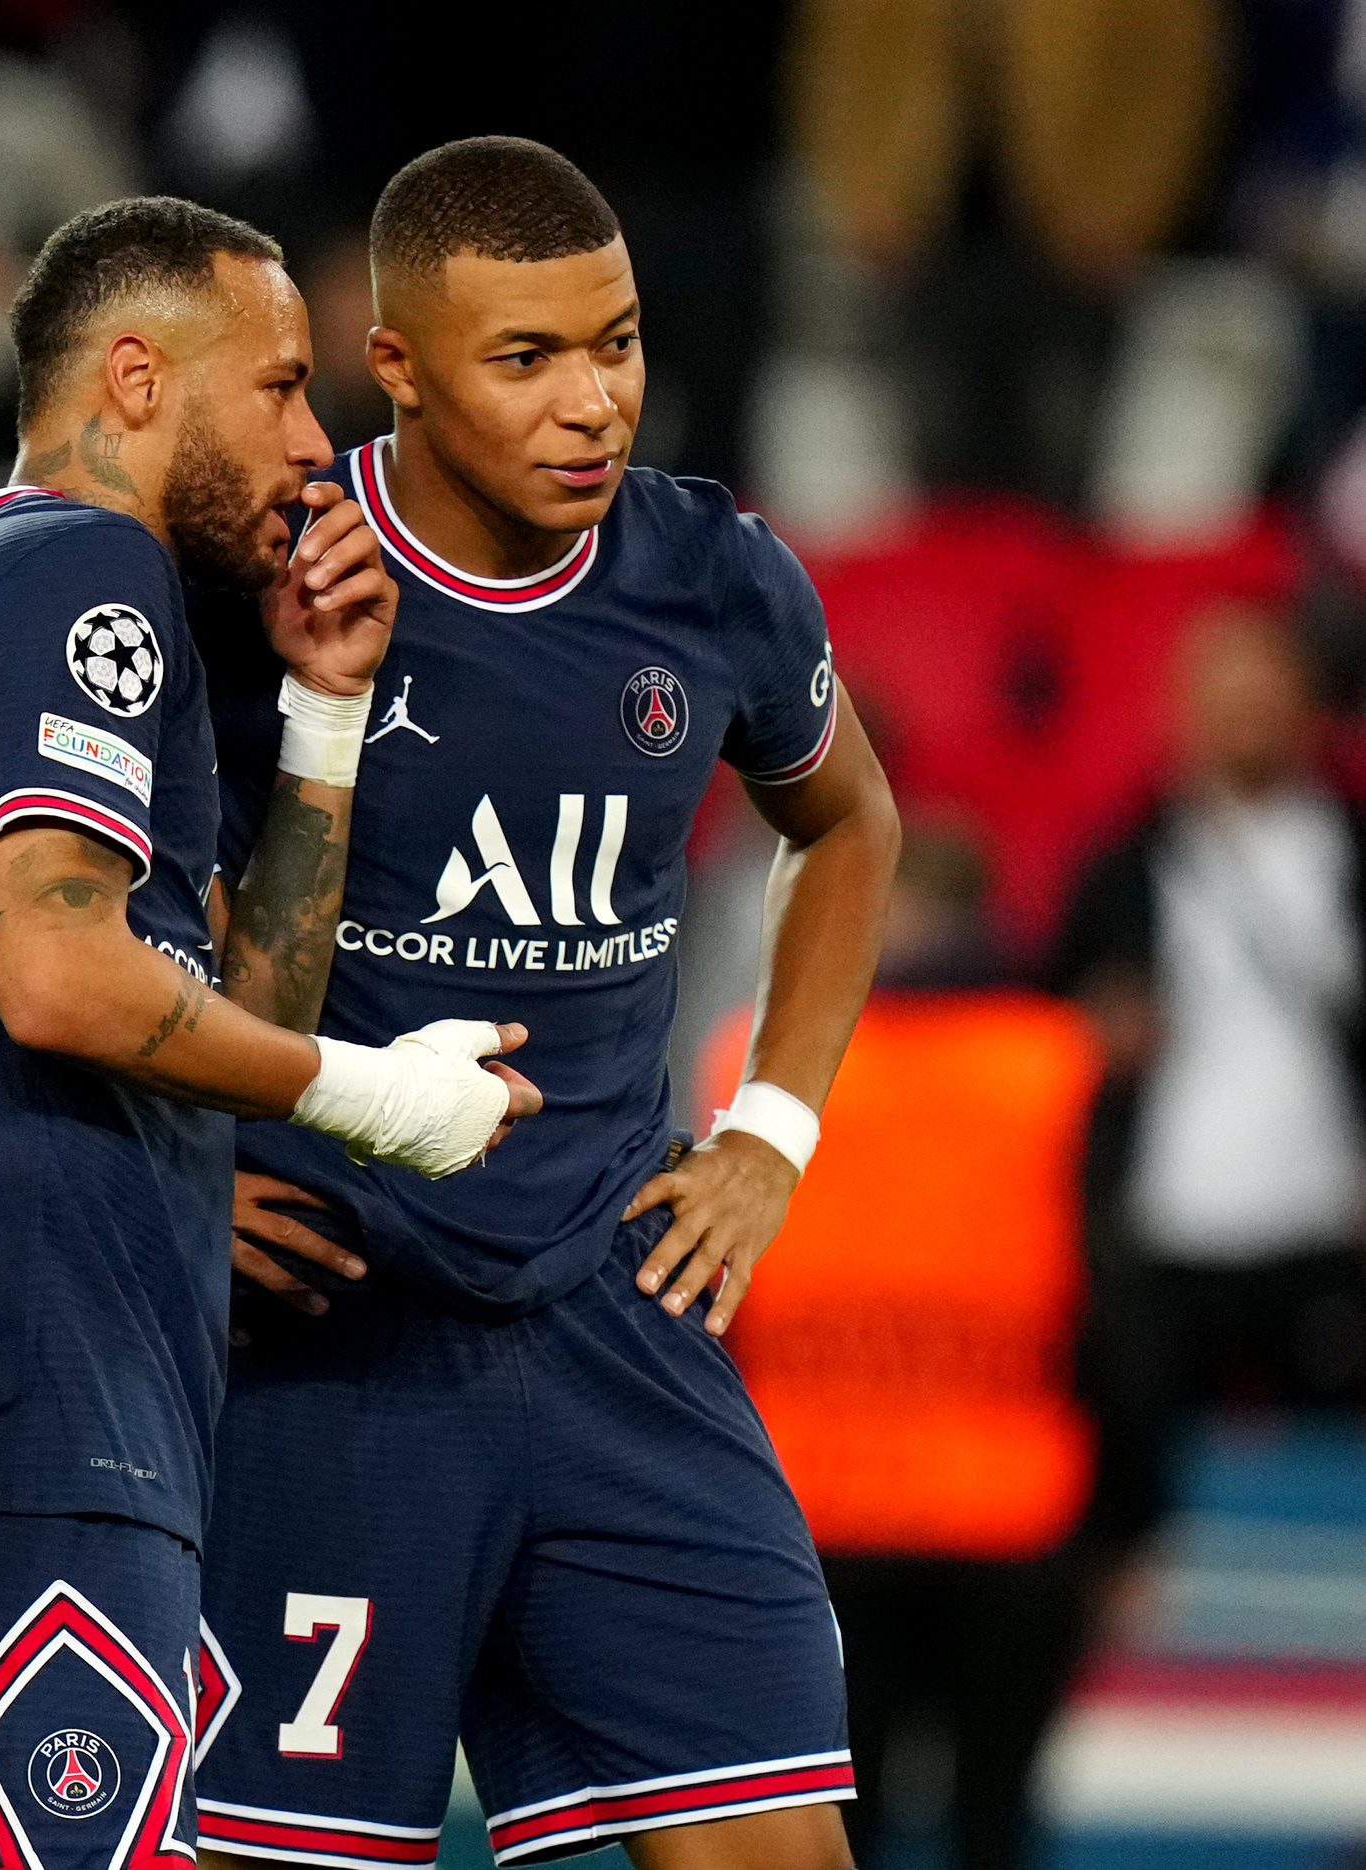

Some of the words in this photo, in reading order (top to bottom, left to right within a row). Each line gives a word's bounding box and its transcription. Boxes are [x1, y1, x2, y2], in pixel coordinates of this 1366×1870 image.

[630, 671, 676, 695] PARIS
[44, 717, 74, 732] UEFA
[335, 920, 455, 966] CCOR
[466, 937, 549, 970] LIVE
[555, 917, 678, 971] LIMITLESS
[90, 1457, 134, 1474] DRI-FI
[278, 1592, 375, 1760] 7
[40, 1733, 101, 1758] PARIS
